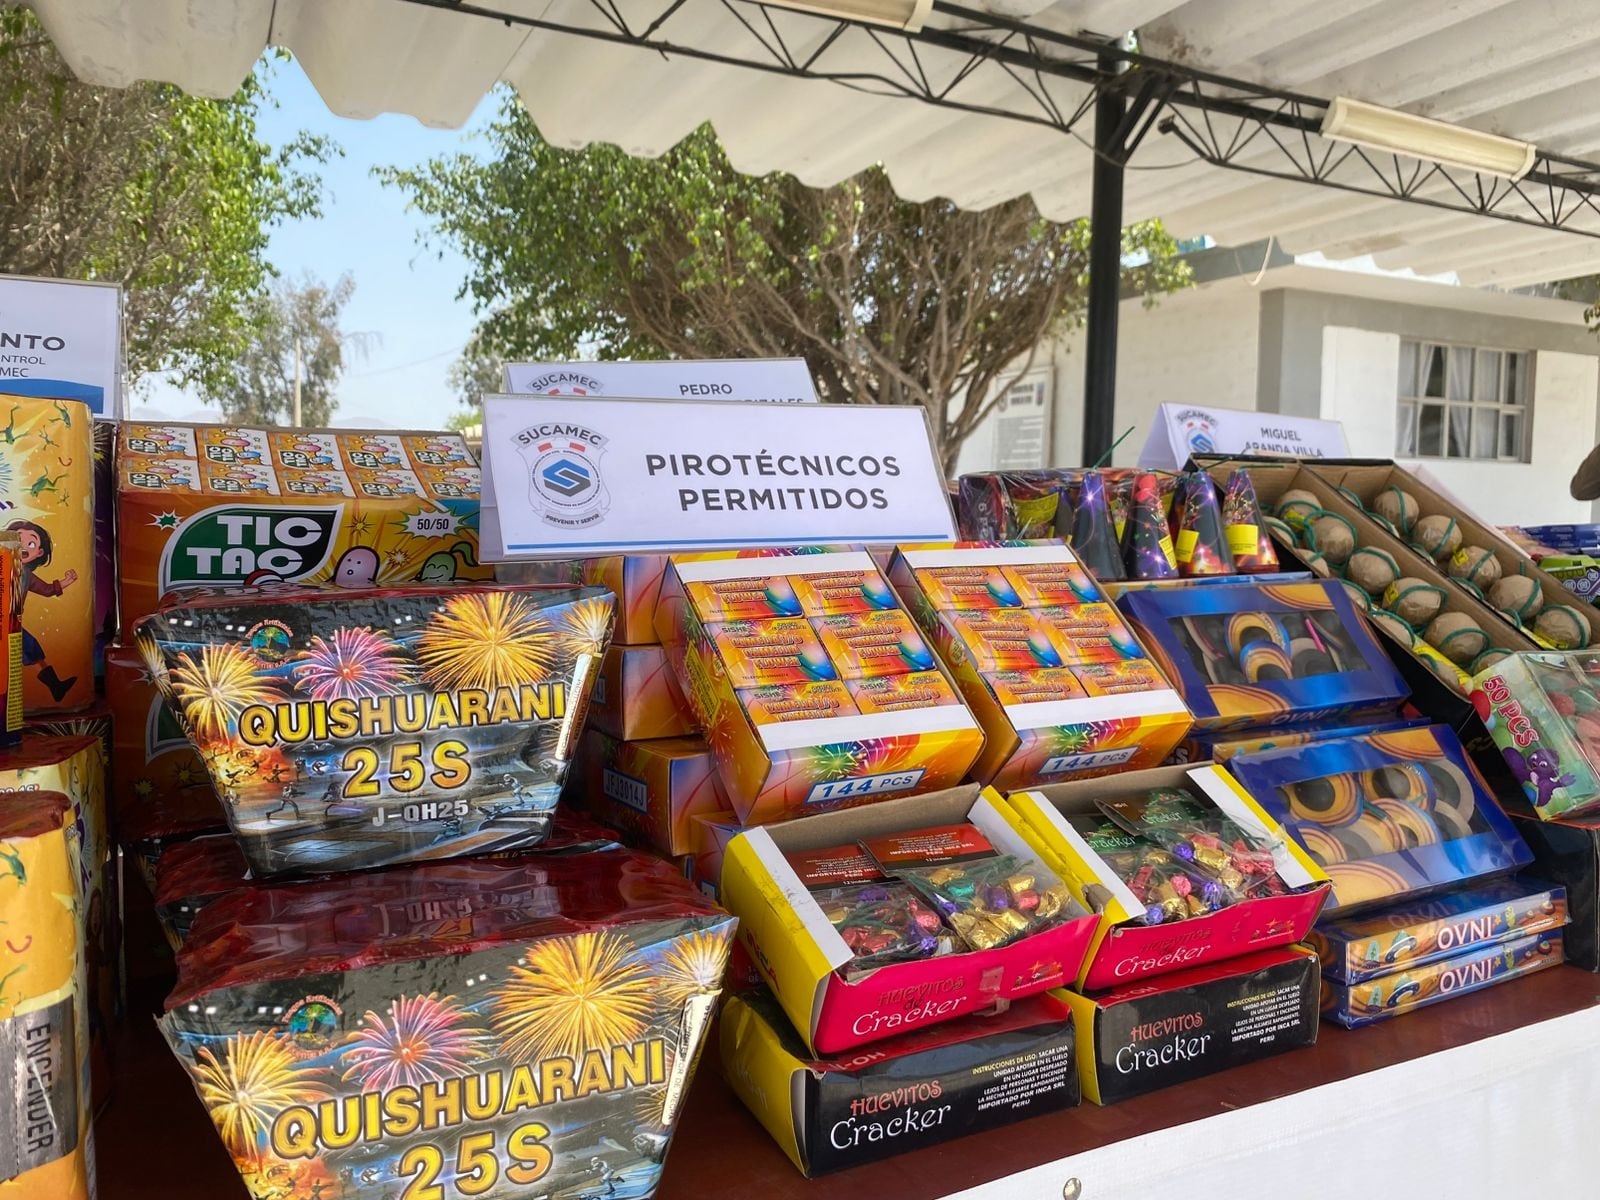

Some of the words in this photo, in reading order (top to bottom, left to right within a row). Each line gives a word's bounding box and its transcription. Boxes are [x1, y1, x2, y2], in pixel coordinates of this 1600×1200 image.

[0, 332, 66, 351] NTO
[0, 366, 30, 378] MEC
[1, 354, 46, 365] NTROL
[532, 372, 600, 392] SUCAMEC
[679, 383, 733, 396] PEDRO
[1176, 409, 1217, 426] SUCAMEC
[518, 424, 602, 445] SUCAMEC
[1260, 427, 1302, 442] MIGUEL
[645, 448, 901, 478] PIROTÉCNICOS
[1292, 445, 1324, 457] VILLA
[679, 487, 889, 512] PERMITIDOS
[217, 515, 323, 546] TIC
[416, 517, 450, 531] 50/50
[545, 514, 575, 525] PREVENIR
[580, 513, 600, 524] SERVIR
[187, 547, 303, 576] TAC
[238, 681, 566, 747] QUISHUARANI
[1482, 675, 1511, 704] 50
[1497, 700, 1539, 747] PCS
[342, 740, 472, 798] 25S
[1051, 754, 1096, 771] 144
[1100, 749, 1129, 764] PCS
[821, 777, 875, 800] 144
[880, 774, 914, 789] PCS
[1436, 916, 1492, 950] OVNI
[1114, 944, 1211, 977] Cracker
[1439, 958, 1492, 993] OVNI
[852, 994, 968, 1037] Cracker
[1130, 1012, 1204, 1043] HUEVITOS
[1231, 1028, 1264, 1042] IMPORTADO
[1265, 1026, 1277, 1034] POR
[1277, 1022, 1290, 1030] INCA
[1290, 1018, 1301, 1027] SRL
[972, 1058, 1016, 1075] INSTRUCCIONES
[1016, 1056, 1024, 1064] DE
[1038, 1047, 1055, 1057] SACAR
[1056, 1044, 1068, 1053] UNA
[993, 1068, 1015, 1078] UNIDAD
[1015, 1061, 1037, 1073] APOYAR
[1051, 1052, 1068, 1062] SUELO
[1115, 1033, 1212, 1075] Cracker
[983, 1086, 1000, 1096] LEJOS
[1000, 1083, 1008, 1091] DE
[1008, 1075, 1035, 1089] PERSONAS
[1040, 1066, 1067, 1079] ENCENDER
[1012, 1073, 1020, 1081] UN
[1021, 1068, 1039, 1079] LUGAR
[1039, 1060, 1068, 1074] DESPEJADO
[26, 1023, 54, 1154] ENCENDER
[271, 1037, 666, 1160] QUISHUARANI
[850, 1079, 943, 1117] HUEVITOS
[978, 1094, 1019, 1111] IMPORTADO
[1020, 1090, 1034, 1099] POR
[1035, 1085, 1052, 1096] INCA
[1052, 1081, 1065, 1090] SRL
[985, 1091, 1005, 1102] MECHA
[1005, 1084, 1030, 1097] ALEJARSE
[1011, 1099, 1031, 1109] PERÚ
[829, 1102, 952, 1151] Cracker
[399, 1122, 554, 1200] 25S
